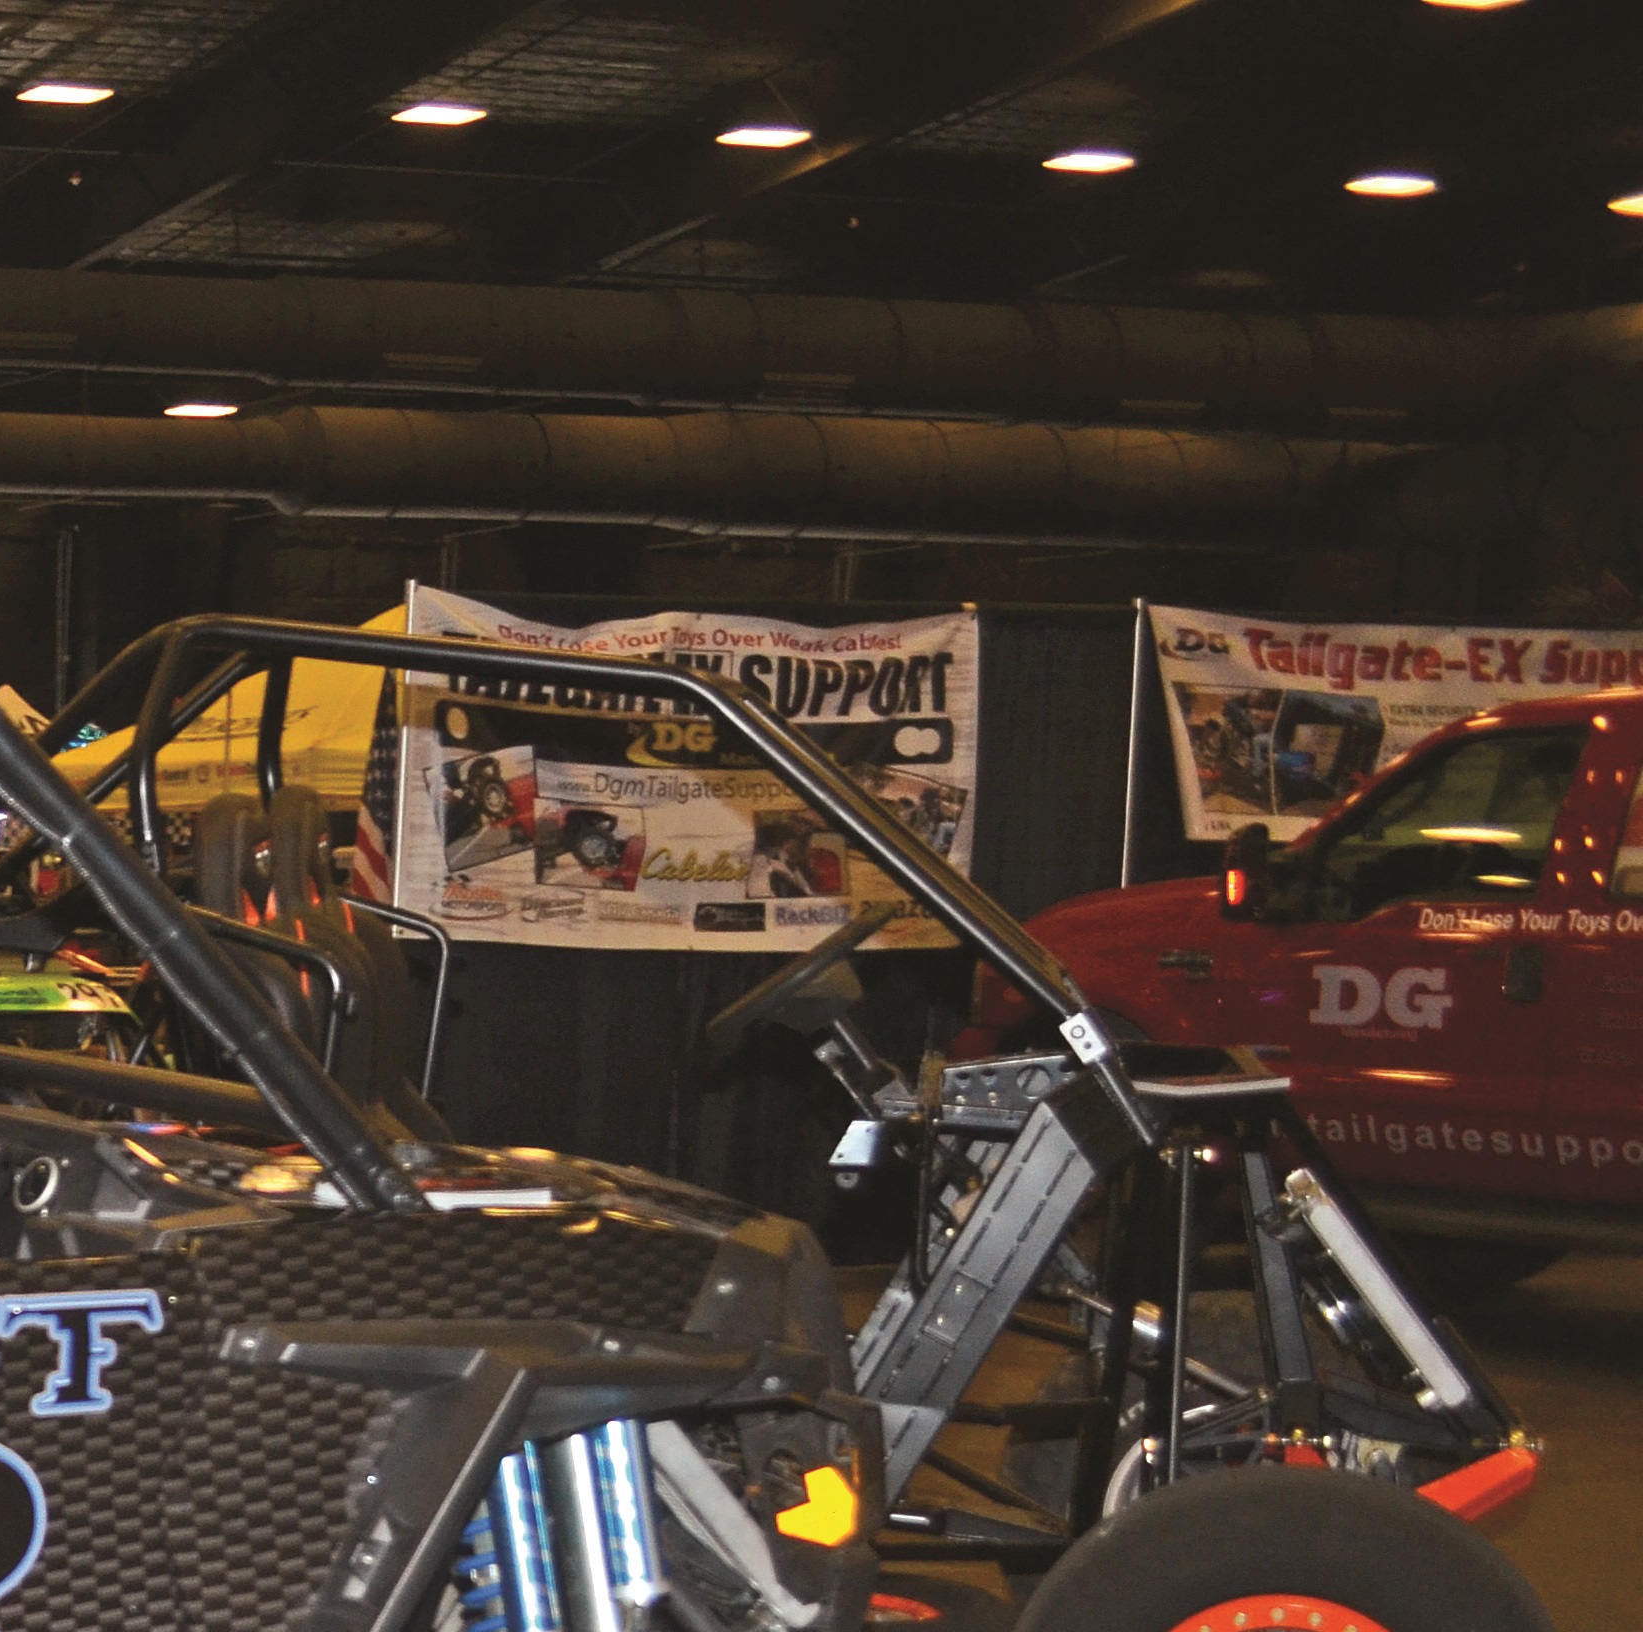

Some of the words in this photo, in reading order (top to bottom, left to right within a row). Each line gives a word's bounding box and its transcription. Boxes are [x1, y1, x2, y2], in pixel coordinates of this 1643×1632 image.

[615, 629, 668, 650] Your
[672, 626, 707, 650] Toys
[712, 628, 765, 649] Over
[770, 630, 828, 653] Weak
[832, 632, 903, 653] Cables!
[1242, 626, 1534, 691] Tailgate-EX
[739, 651, 955, 720] SUPPORT
[650, 722, 718, 752] DG
[1520, 908, 1563, 931] Your
[1567, 908, 1611, 936] Toys
[1308, 964, 1454, 1030] DG
